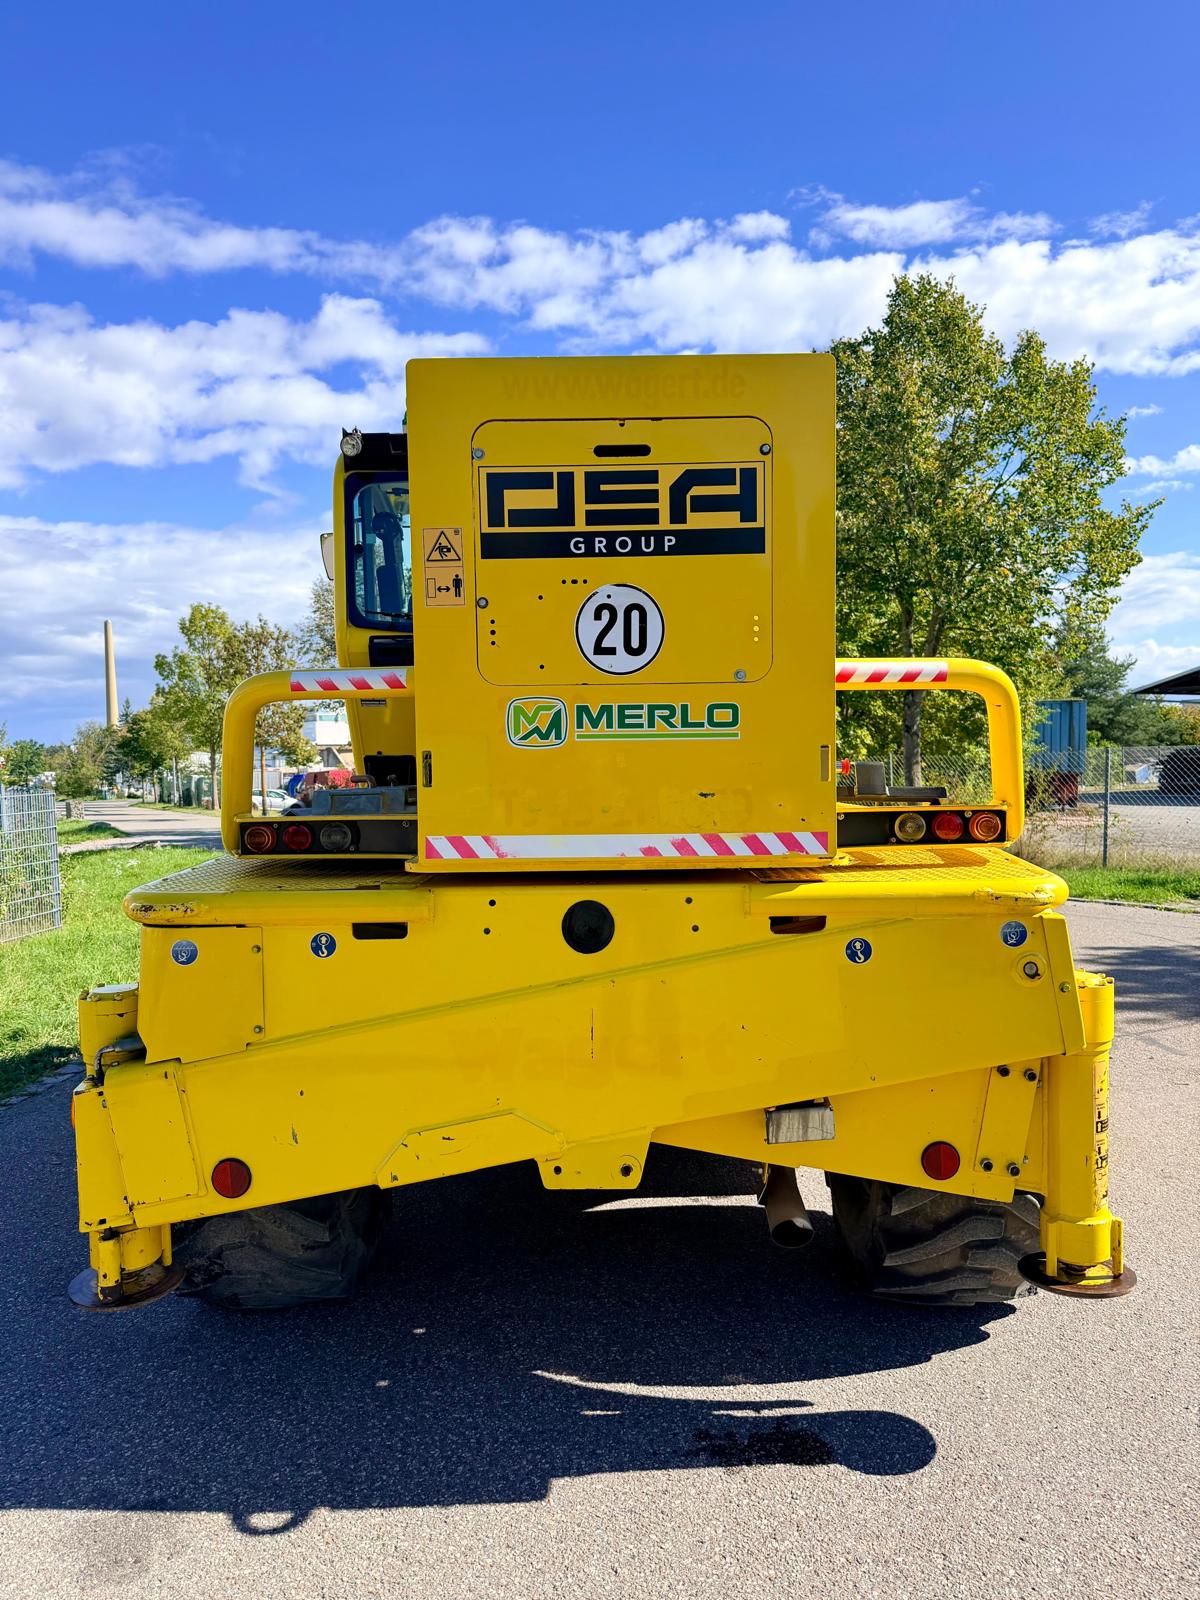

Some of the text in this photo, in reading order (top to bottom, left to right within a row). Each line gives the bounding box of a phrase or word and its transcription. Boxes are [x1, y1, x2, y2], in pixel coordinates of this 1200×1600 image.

[569, 535, 677, 555] GROUP
[592, 602, 649, 657] 20
[575, 701, 741, 730] MERLO
